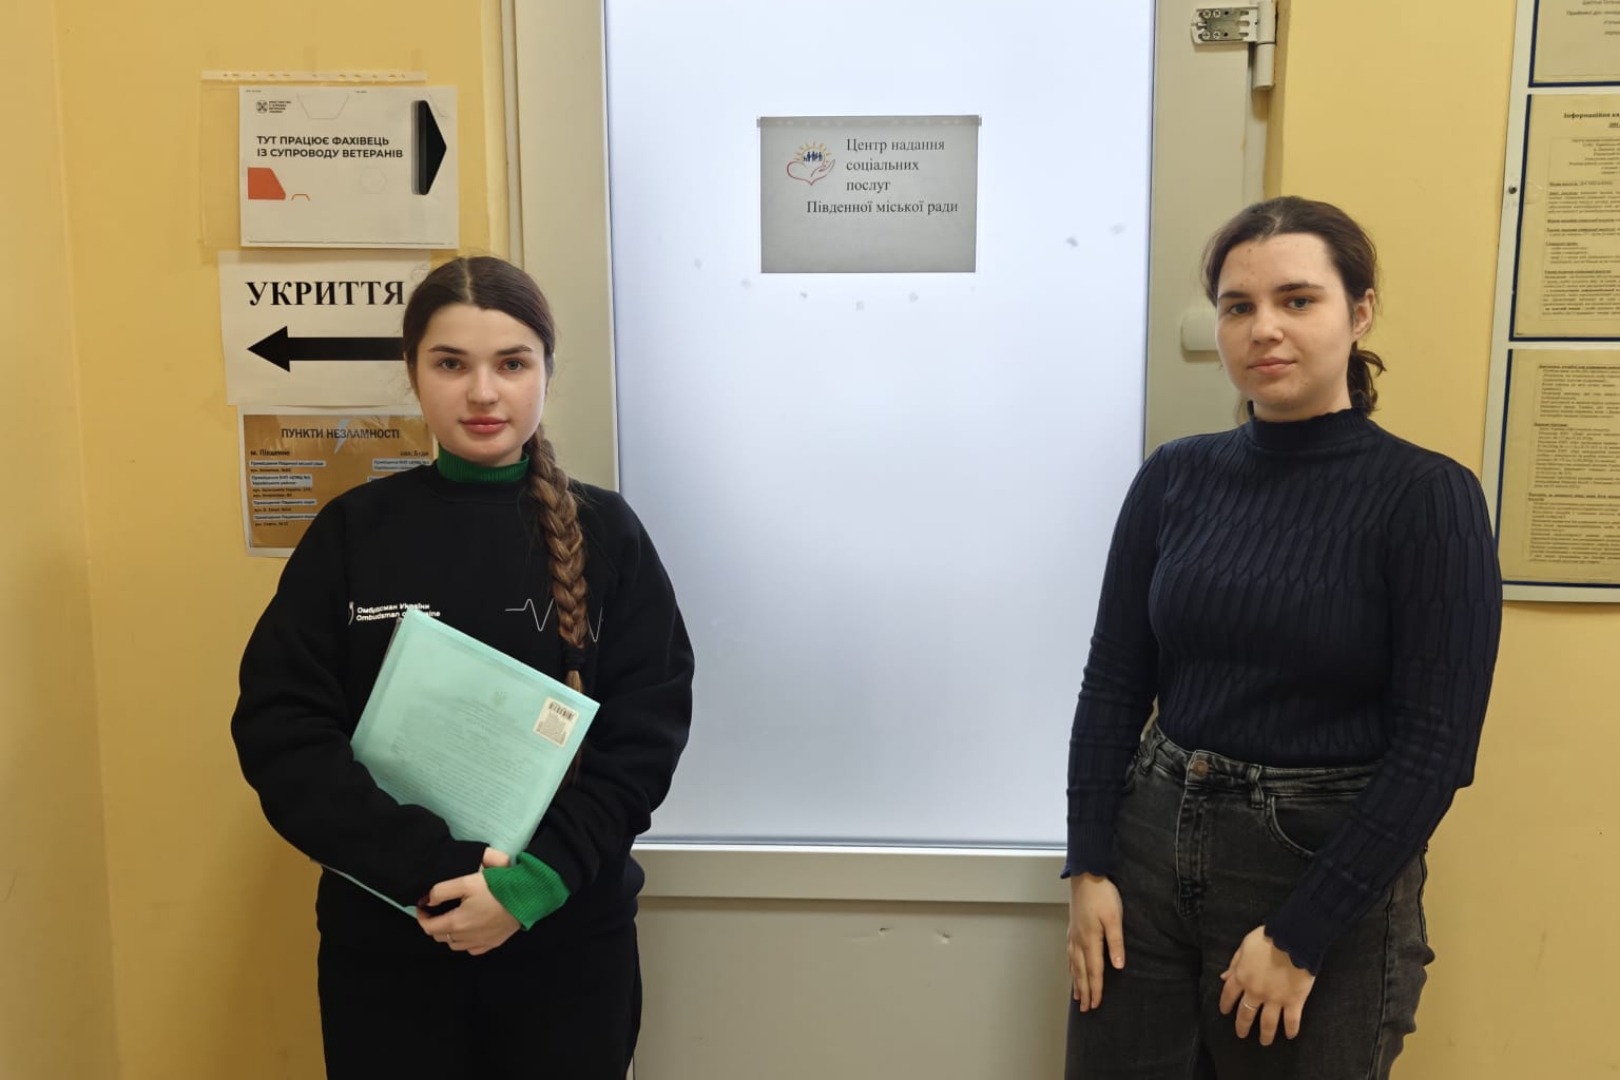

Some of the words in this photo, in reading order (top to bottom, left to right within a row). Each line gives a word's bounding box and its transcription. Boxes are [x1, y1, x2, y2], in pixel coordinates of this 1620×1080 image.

[257, 136, 277, 145] ТУТ
[280, 136, 329, 146] ПРАЦЮЄ
[332, 136, 389, 147] ФАХІВЕЦЬ
[847, 138, 887, 153] Центр
[891, 140, 945, 152] надання
[257, 148, 268, 157] ІЗ
[270, 148, 339, 159] СУПРОВОДУ
[342, 149, 403, 158] ВЕТЕРАНІВ
[846, 158, 919, 172] соціальних
[846, 181, 891, 193] послуг
[807, 200, 873, 214] Південної
[876, 200, 924, 213] міської
[927, 202, 958, 215] ради
[245, 281, 406, 306] УКРИТТЯ
[281, 428, 323, 439] ПУНКТИ
[326, 428, 400, 439] НЕЗЛАМНОСТІ
[357, 605, 398, 614] Омбудсман
[356, 611, 400, 621] Ombudsman
